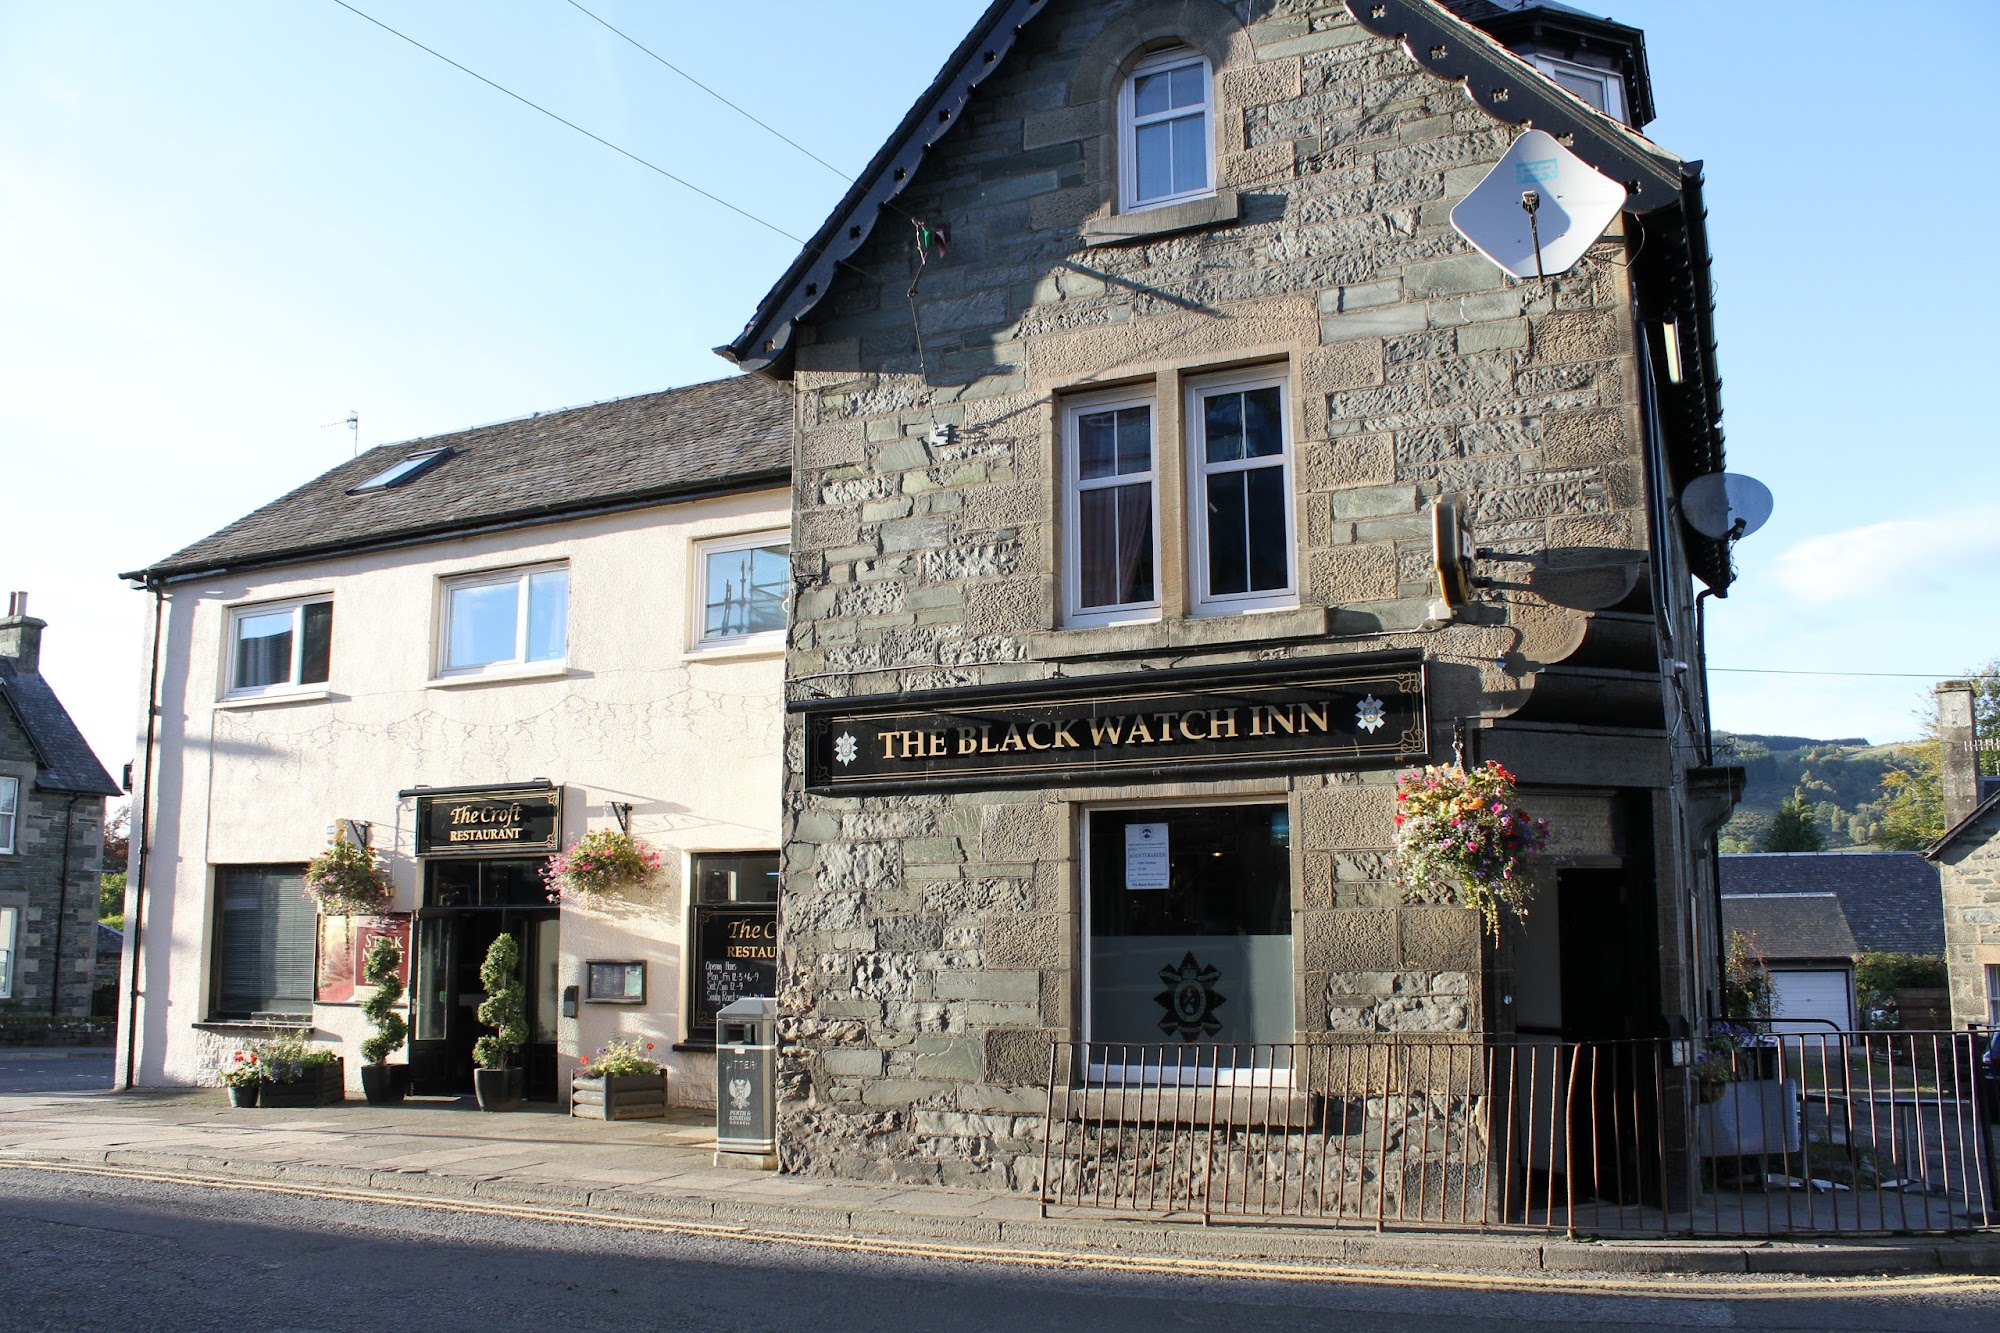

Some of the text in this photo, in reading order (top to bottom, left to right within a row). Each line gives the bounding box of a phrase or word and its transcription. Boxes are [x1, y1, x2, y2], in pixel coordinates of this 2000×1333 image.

[878, 701, 1331, 760] THE BLACK WATCH INN
[450, 802, 523, 828] The Croft
[450, 828, 524, 842] RESTAURANT
[728, 918, 761, 939] The
[365, 933, 404, 949] STK
